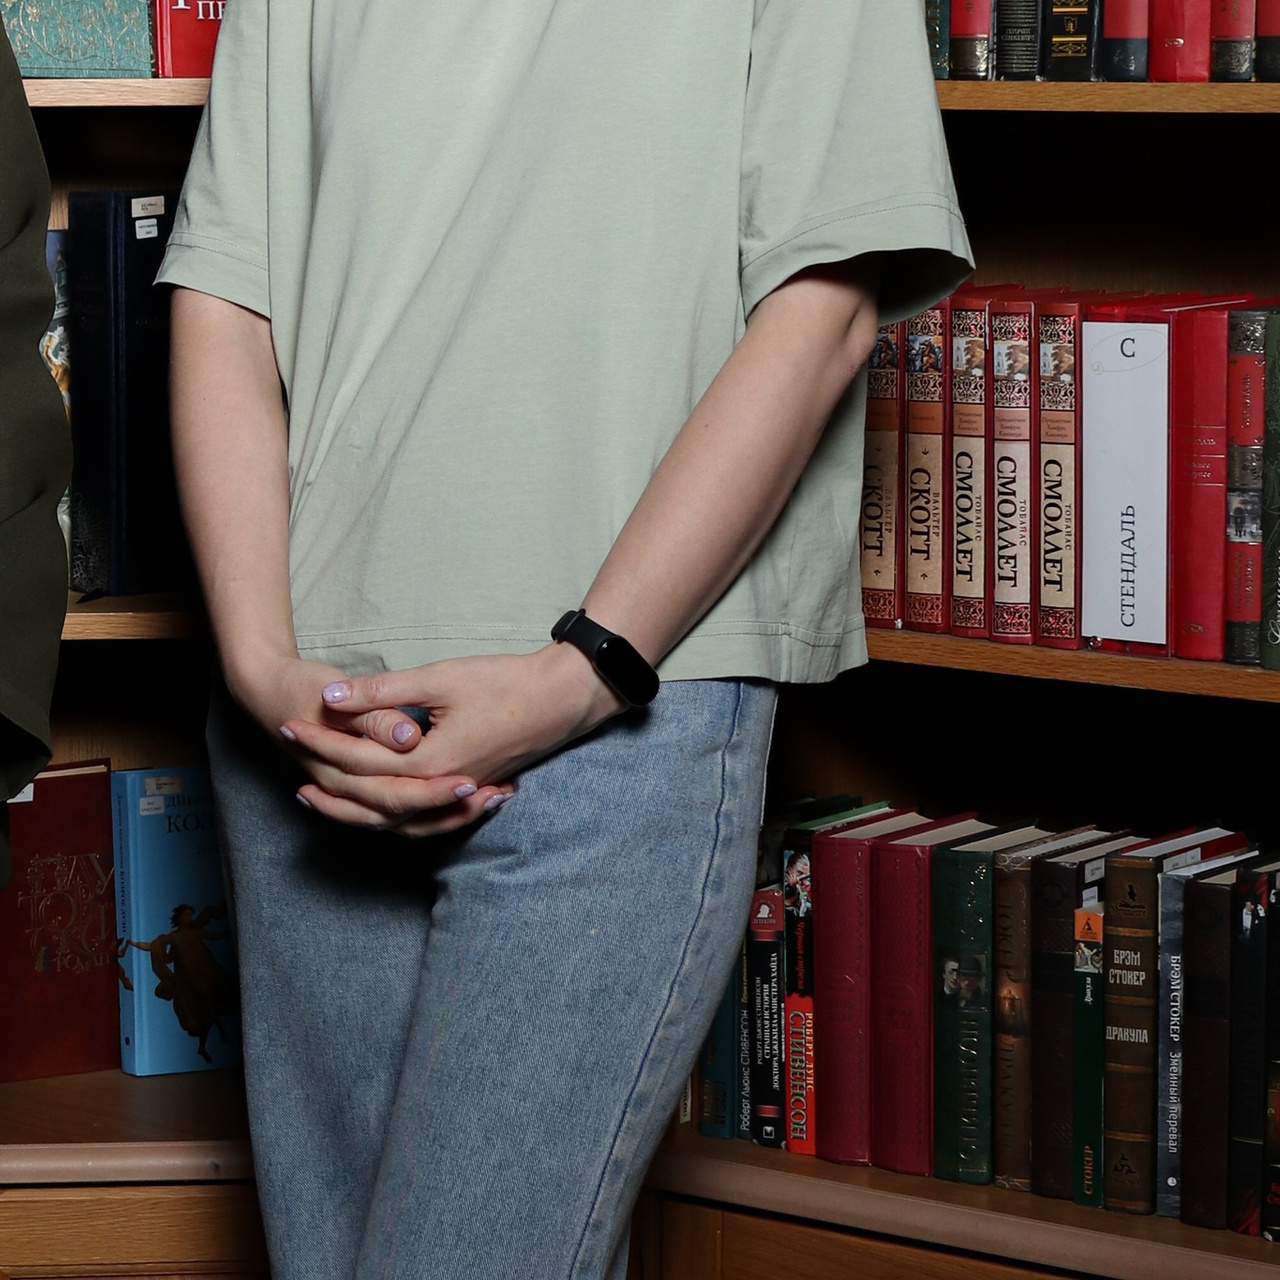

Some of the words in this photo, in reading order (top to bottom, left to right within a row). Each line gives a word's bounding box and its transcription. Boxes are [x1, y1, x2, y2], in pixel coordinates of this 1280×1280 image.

[1120, 337, 1136, 359] С
[863, 464, 884, 557] СКОТТ
[909, 467, 932, 561] СКОТТ
[932, 492, 940, 538] ВАЛЬТЕР
[954, 451, 974, 582] СМОЛЛЕТ
[996, 455, 1017, 588] СМОЛЛЕТ
[1042, 458, 1064, 592] СМОЛЛЕТ
[1120, 505, 1137, 628] СТЕНДАЛЬ
[1108, 968, 1146, 986] СТОКЕР
[1113, 948, 1142, 967] БРЭМ
[1170, 954, 1182, 990] БРЭМ
[762, 984, 770, 1019] ИСТОРИЯ
[1169, 992, 1182, 1043] СТОКЕР
[740, 1009, 750, 1068] СТИВЕНСОН
[763, 1019, 771, 1059] СТРАННАЯ
[805, 1012, 815, 1055] РОБЕРТ
[1105, 1025, 1149, 1044] ДРАКУЛА
[740, 1069, 751, 1100] Льюис
[788, 1010, 808, 1141] СТИВЕНСОН
[806, 1058, 815, 1092] ЛУИС
[1168, 1051, 1183, 1103] Змеиный
[739, 1101, 751, 1131] Роберт
[1166, 1107, 1179, 1153] перевал
[1083, 1144, 1095, 1196] СТОКЕР
